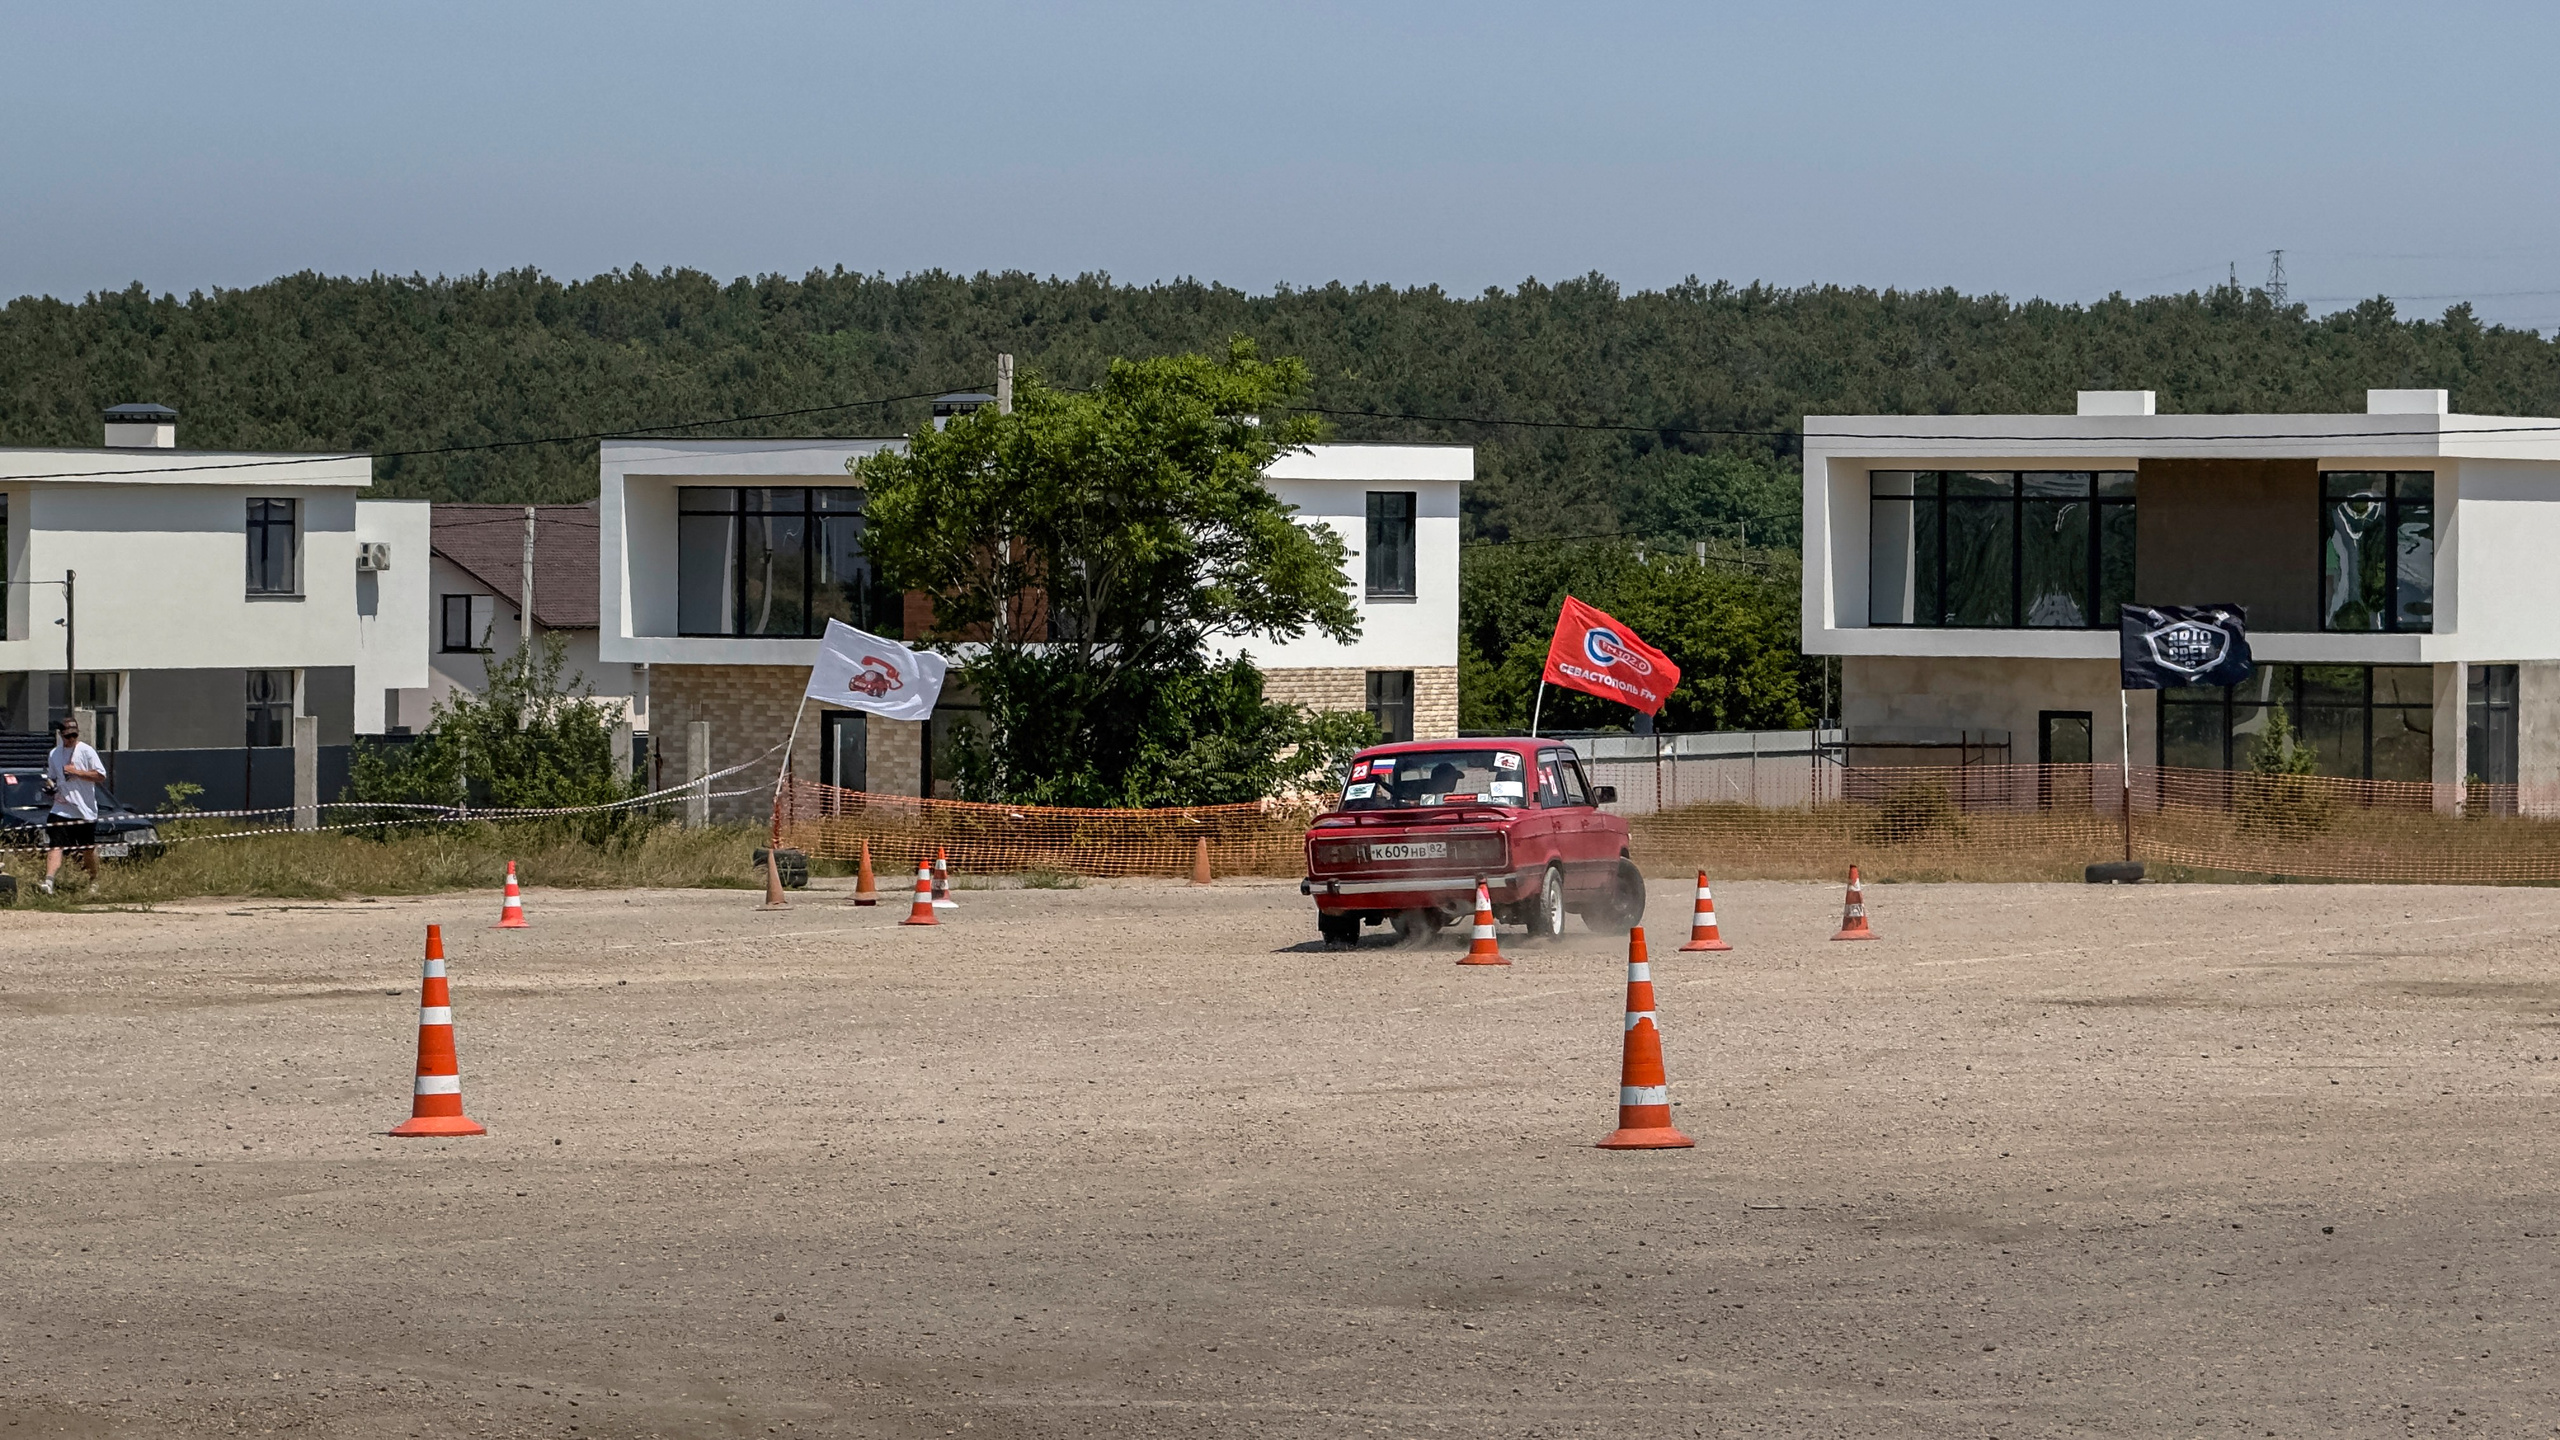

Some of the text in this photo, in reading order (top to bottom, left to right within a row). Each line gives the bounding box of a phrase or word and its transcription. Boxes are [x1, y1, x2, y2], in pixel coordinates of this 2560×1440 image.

[1559, 663, 1657, 702] СЕВАСТОПОЛЬ FM
[1353, 765, 1368, 778] 23
[1429, 843, 1442, 853] 82
